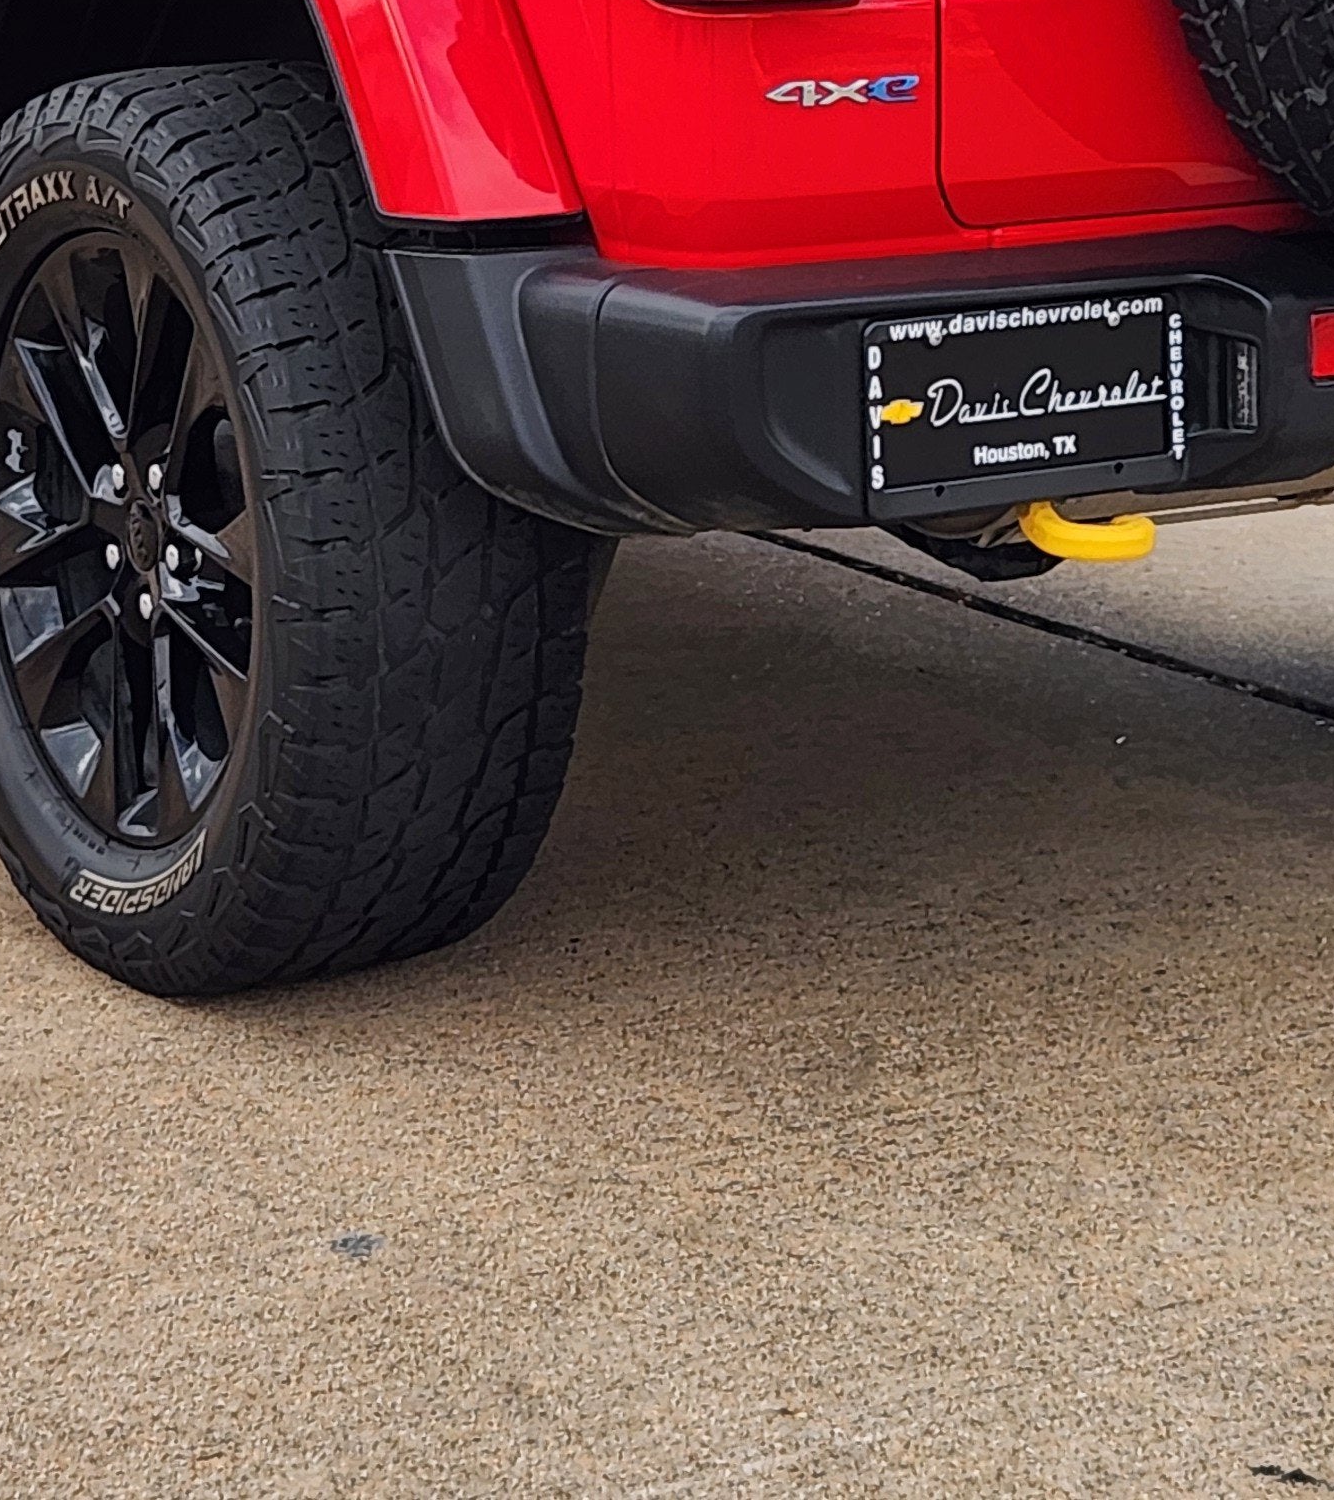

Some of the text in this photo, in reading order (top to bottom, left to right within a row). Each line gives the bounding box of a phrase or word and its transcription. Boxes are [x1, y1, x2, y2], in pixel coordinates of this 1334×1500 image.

[85, 175, 135, 220] A/T
[888, 297, 1164, 342] www.davischevrolet.com
[926, 367, 1168, 428] Davis Chevrolet
[1168, 312, 1186, 461] CHEVROLET
[867, 345, 885, 490] DAVIS
[973, 434, 1077, 466] Houston, TX
[69, 828, 207, 915] LANDSPIDER
